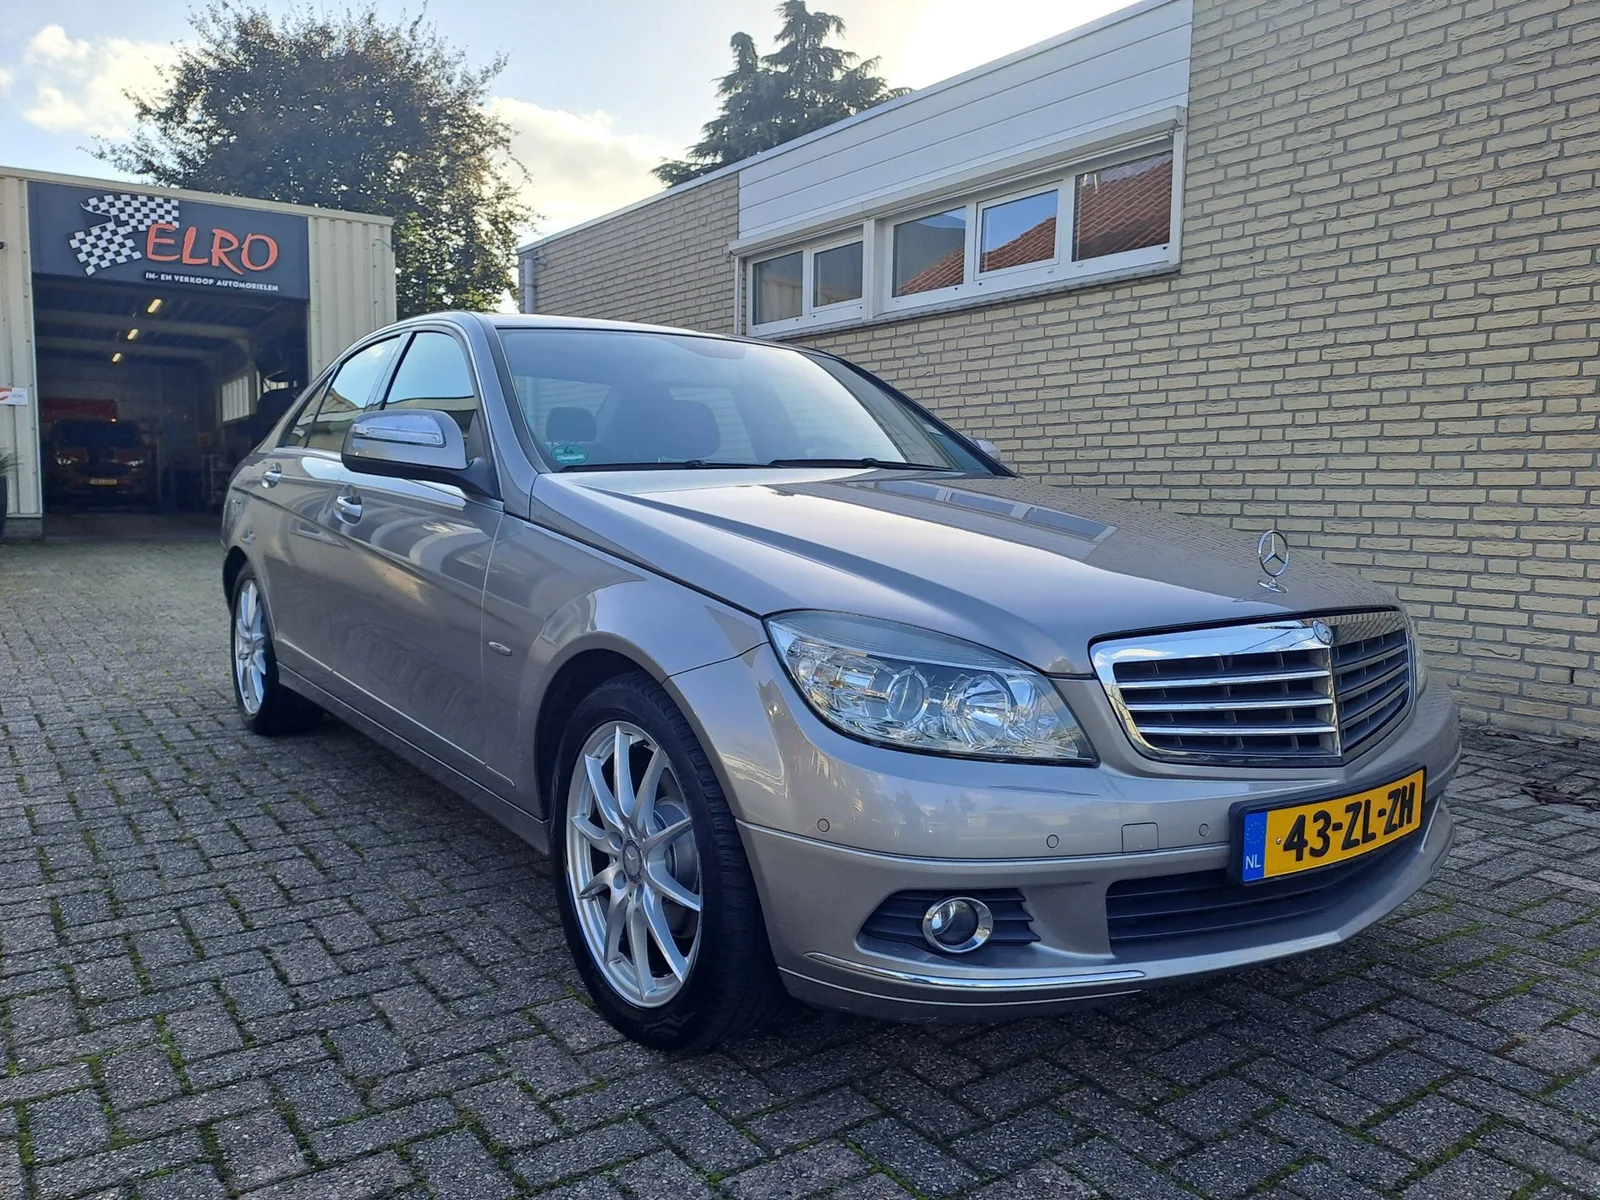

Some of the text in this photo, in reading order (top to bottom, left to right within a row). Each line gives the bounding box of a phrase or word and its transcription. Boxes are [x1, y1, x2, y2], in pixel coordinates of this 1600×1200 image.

[147, 223, 278, 275] ELRO
[145, 272, 279, 291] IN- EN VERKOOP AUTOMOBIELEN
[1283, 781, 1416, 862] 43-ZL-ZH
[1245, 855, 1262, 870] NL
